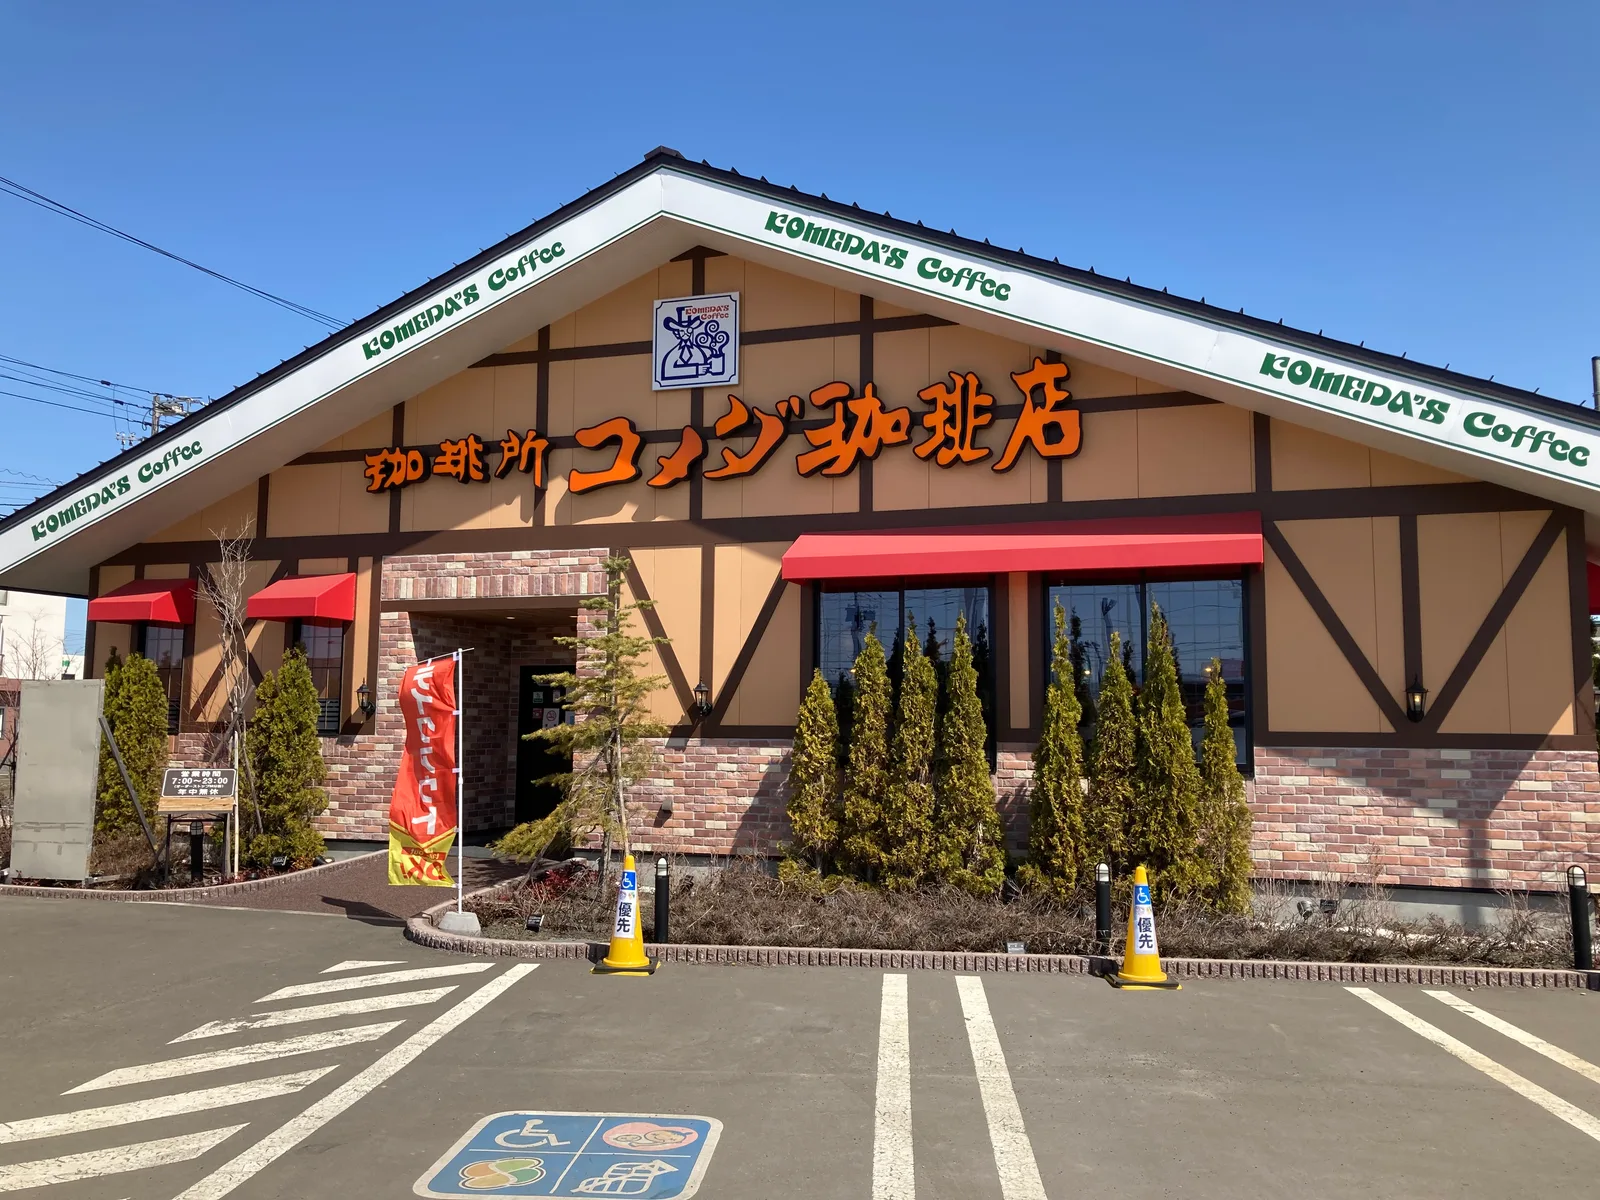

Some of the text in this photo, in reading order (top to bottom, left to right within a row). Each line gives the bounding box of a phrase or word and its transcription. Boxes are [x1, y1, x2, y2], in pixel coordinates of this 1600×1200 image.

[361, 241, 566, 360] KOMEDA'S Coffee
[763, 210, 1012, 301] KOMEDA'S Coffee
[685, 304, 729, 315] KOMEDA'S
[701, 312, 729, 320] Coffee
[364, 357, 1082, 494] 珈琲所 コメダ珈琲店
[1258, 351, 1591, 467] KOMEDA'S Coffee
[30, 440, 203, 541] KOMEDA'S Coffee
[616, 902, 632, 933] 優先
[1137, 917, 1153, 949] 優先
